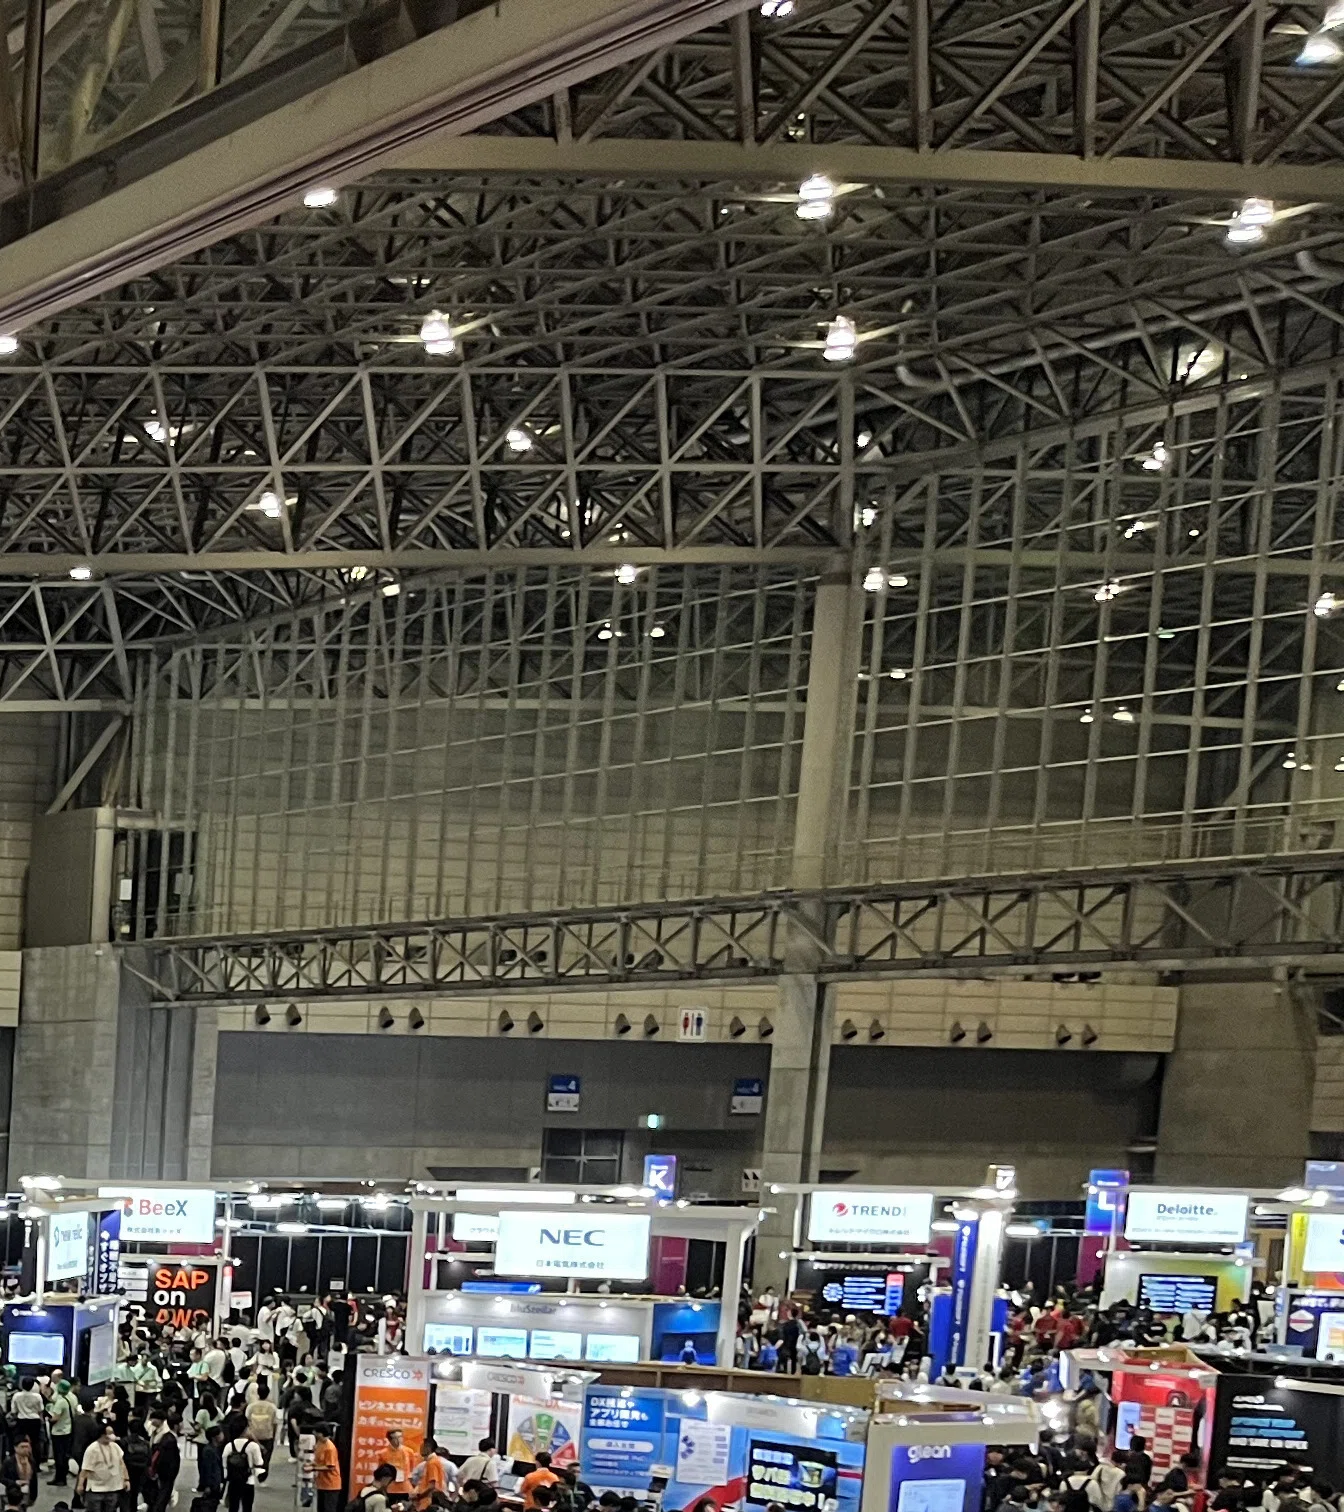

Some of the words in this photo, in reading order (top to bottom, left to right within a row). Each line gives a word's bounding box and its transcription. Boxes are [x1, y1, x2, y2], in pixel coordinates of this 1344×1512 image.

[649, 1170, 668, 1190] K
[139, 1199, 188, 1217] BeeX
[1098, 1191, 1117, 1211] L
[852, 1205, 902, 1217] TREND
[539, 1228, 606, 1247] NEC
[154, 1268, 210, 1290] SAP
[153, 1289, 186, 1306] on
[362, 1367, 411, 1380] CRESCO
